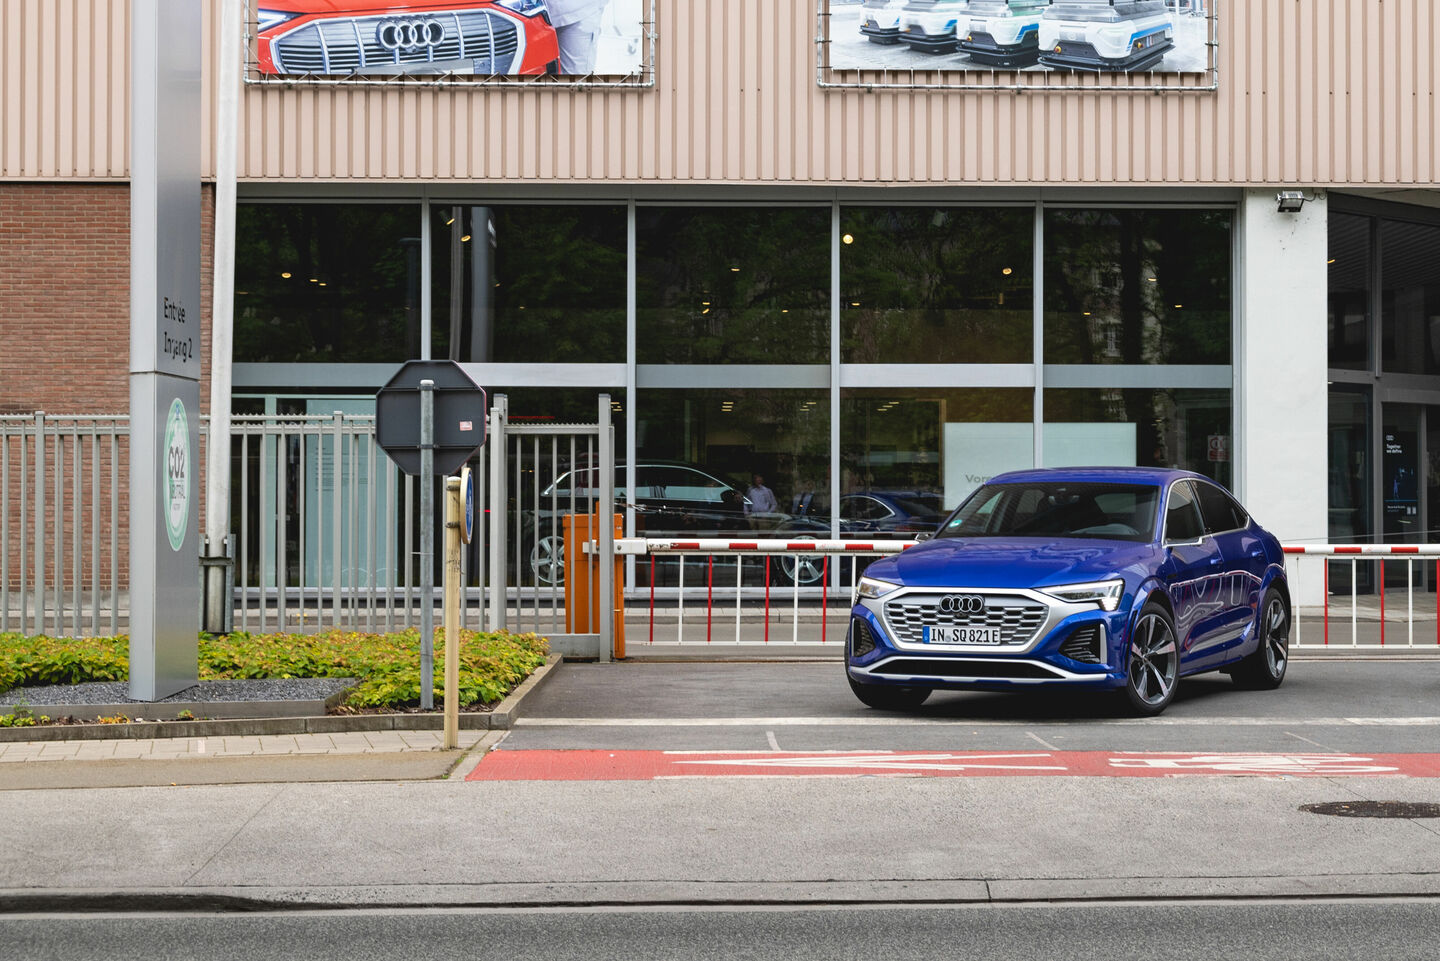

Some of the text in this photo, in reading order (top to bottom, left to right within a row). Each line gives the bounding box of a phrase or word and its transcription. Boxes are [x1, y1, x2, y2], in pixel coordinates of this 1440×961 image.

[187, 337, 193, 359] 2
[168, 445, 185, 479] CO2
[931, 628, 945, 642] IN
[952, 629, 967, 643] SQ
